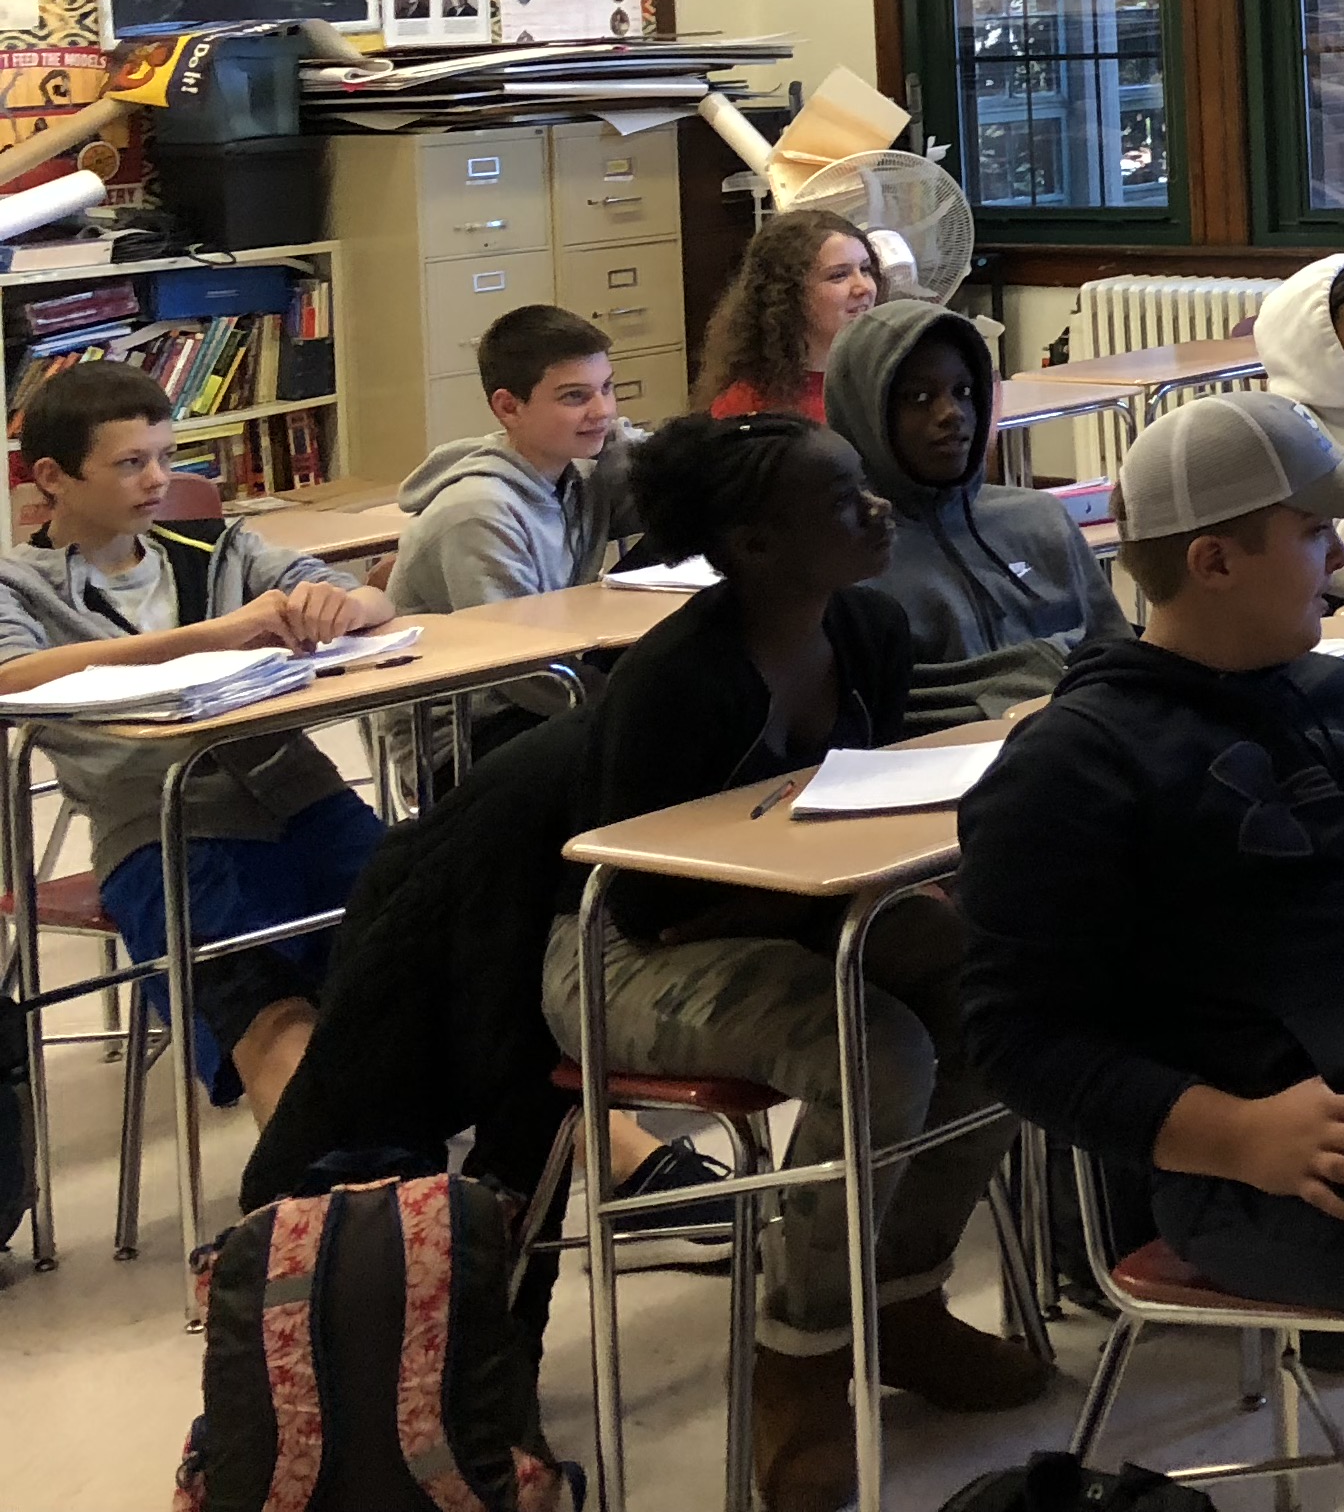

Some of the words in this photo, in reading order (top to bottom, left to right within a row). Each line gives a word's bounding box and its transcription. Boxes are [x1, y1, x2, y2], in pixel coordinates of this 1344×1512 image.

[12, 52, 40, 66] FEED
[41, 52, 62, 67] THE
[188, 43, 210, 69] Do
